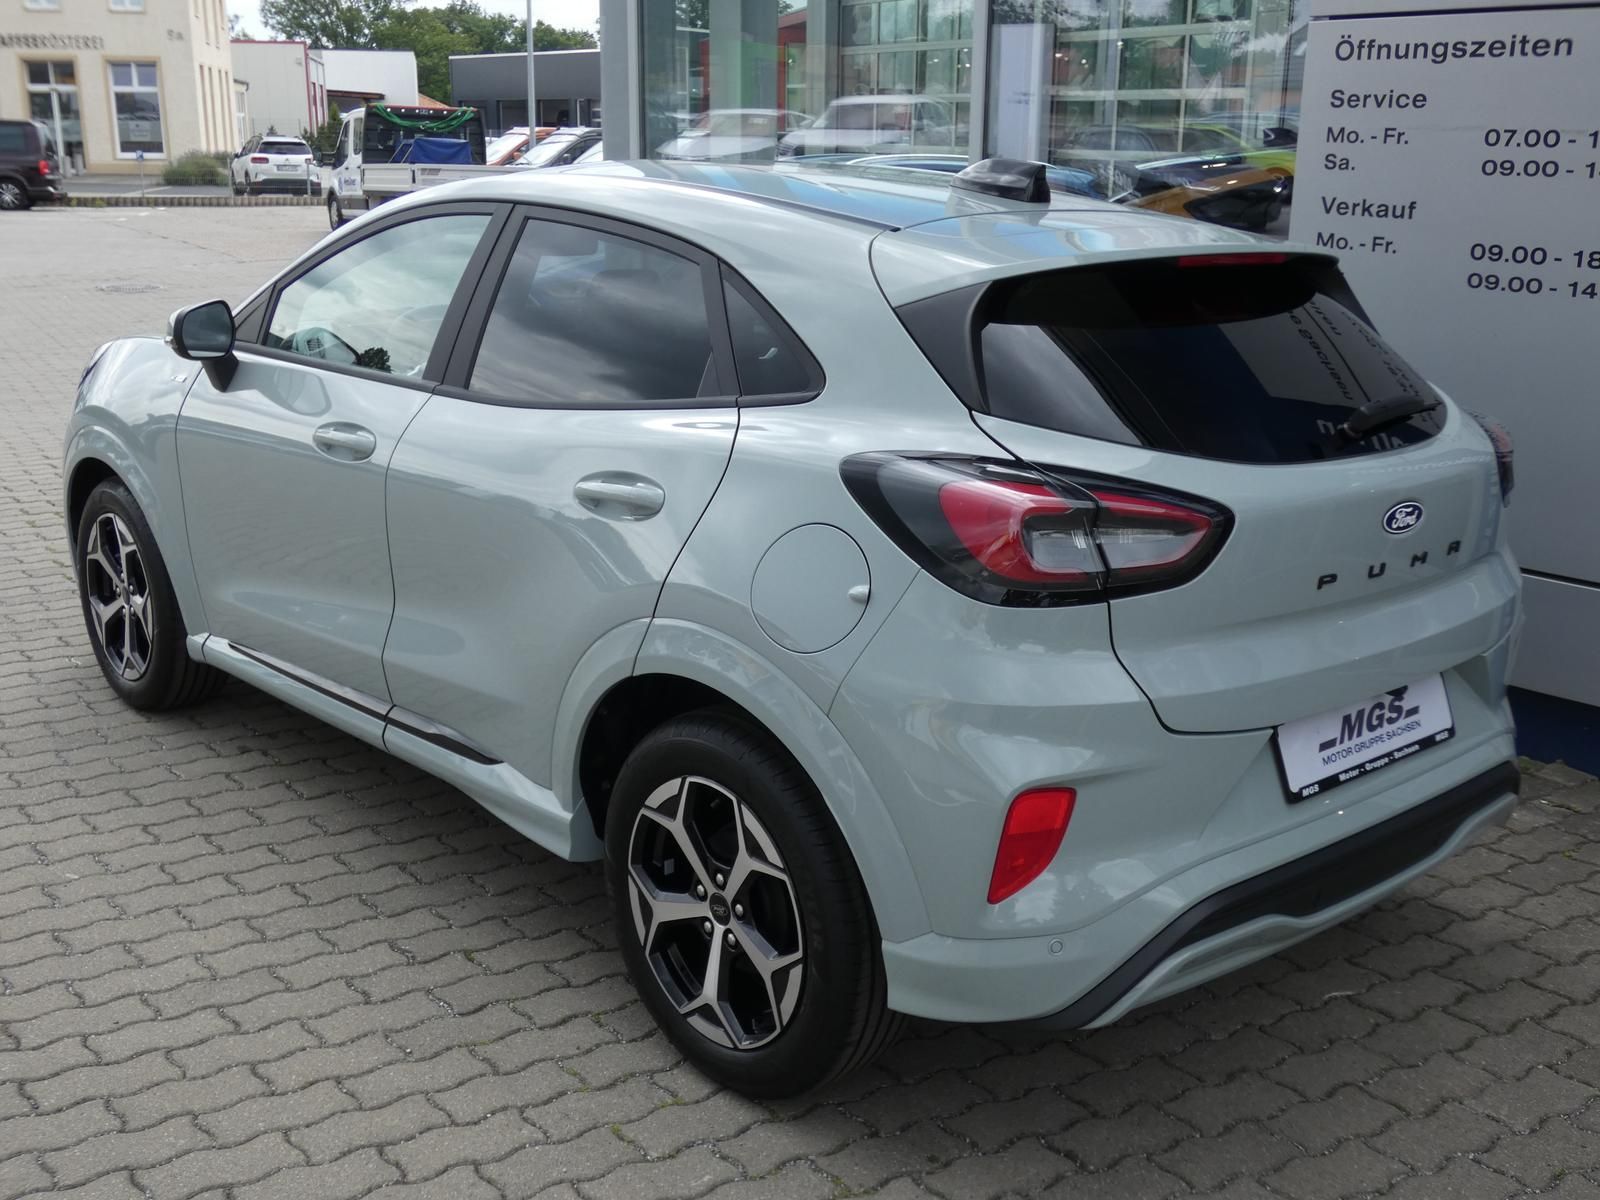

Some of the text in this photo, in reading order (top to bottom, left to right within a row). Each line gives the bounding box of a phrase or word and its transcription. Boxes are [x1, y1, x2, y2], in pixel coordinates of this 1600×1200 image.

[1334, 34, 1575, 64] Öffnungszeiten
[1329, 89, 1428, 110] Service
[1484, 128, 1561, 148] 07.00
[1323, 153, 1356, 171] Sa.
[1481, 159, 1560, 178] 09.00
[1321, 196, 1417, 220] Verkauf
[1470, 243, 1548, 265] 09.00
[1467, 272, 1543, 294] 09.00
[1391, 506, 1419, 529] Ford
[1316, 540, 1462, 590] PUMA
[1339, 696, 1404, 746] MGS
[1321, 719, 1422, 767] MOTOR GRUPPE SACHSEN
[1302, 784, 1320, 798] MGS
[1338, 768, 1360, 782] Motor
[1364, 757, 1389, 771] Gruppe
[1393, 744, 1420, 760] Sachsen
[1434, 730, 1449, 742] MGS
